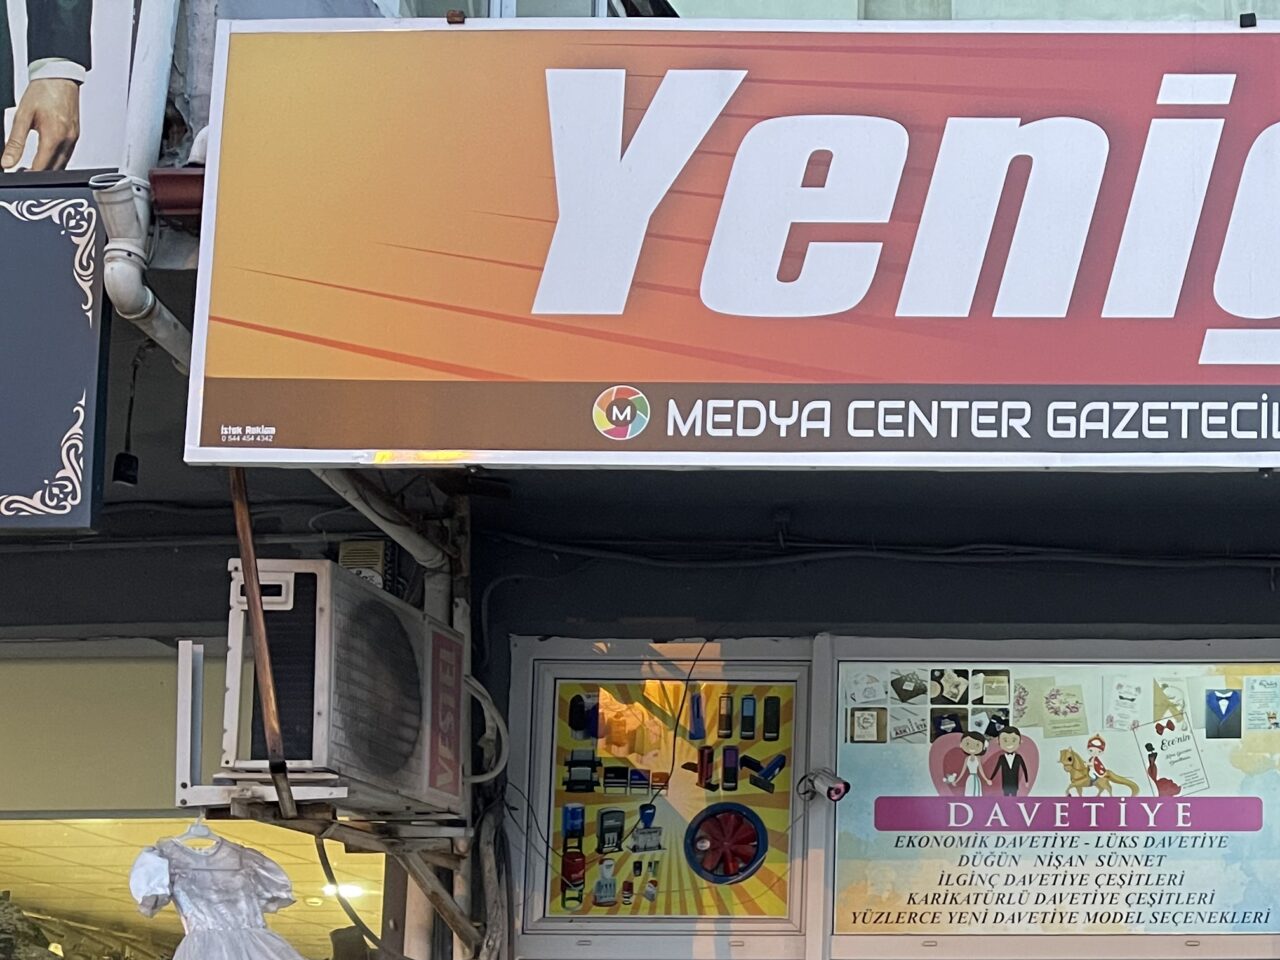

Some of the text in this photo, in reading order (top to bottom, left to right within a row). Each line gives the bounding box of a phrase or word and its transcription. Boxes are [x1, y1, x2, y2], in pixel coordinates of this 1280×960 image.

[667, 400, 831, 438] MEDYA
[872, 401, 1033, 439] CENTER
[948, 797, 1193, 828] DAVETİYE
[894, 833, 990, 849] EKONOMİK
[994, 833, 1079, 849] DAVETİYE
[1094, 833, 1139, 849] LÜKS
[1143, 833, 1229, 849] DAVETİYE
[957, 851, 1166, 869] DÜĞÜN NİŞAN SÜNNET
[938, 871, 1185, 889] İLGİNÇ DAVETİYE ÇEŞİTLERİ
[906, 889, 1216, 908] KARİKATÜRLÜ DAVETİYE ÇEŞİTLERİ
[850, 909, 1271, 926] YÜZLERCE YENİ DAVETİYE MODEL SEÇENEKLERİ
